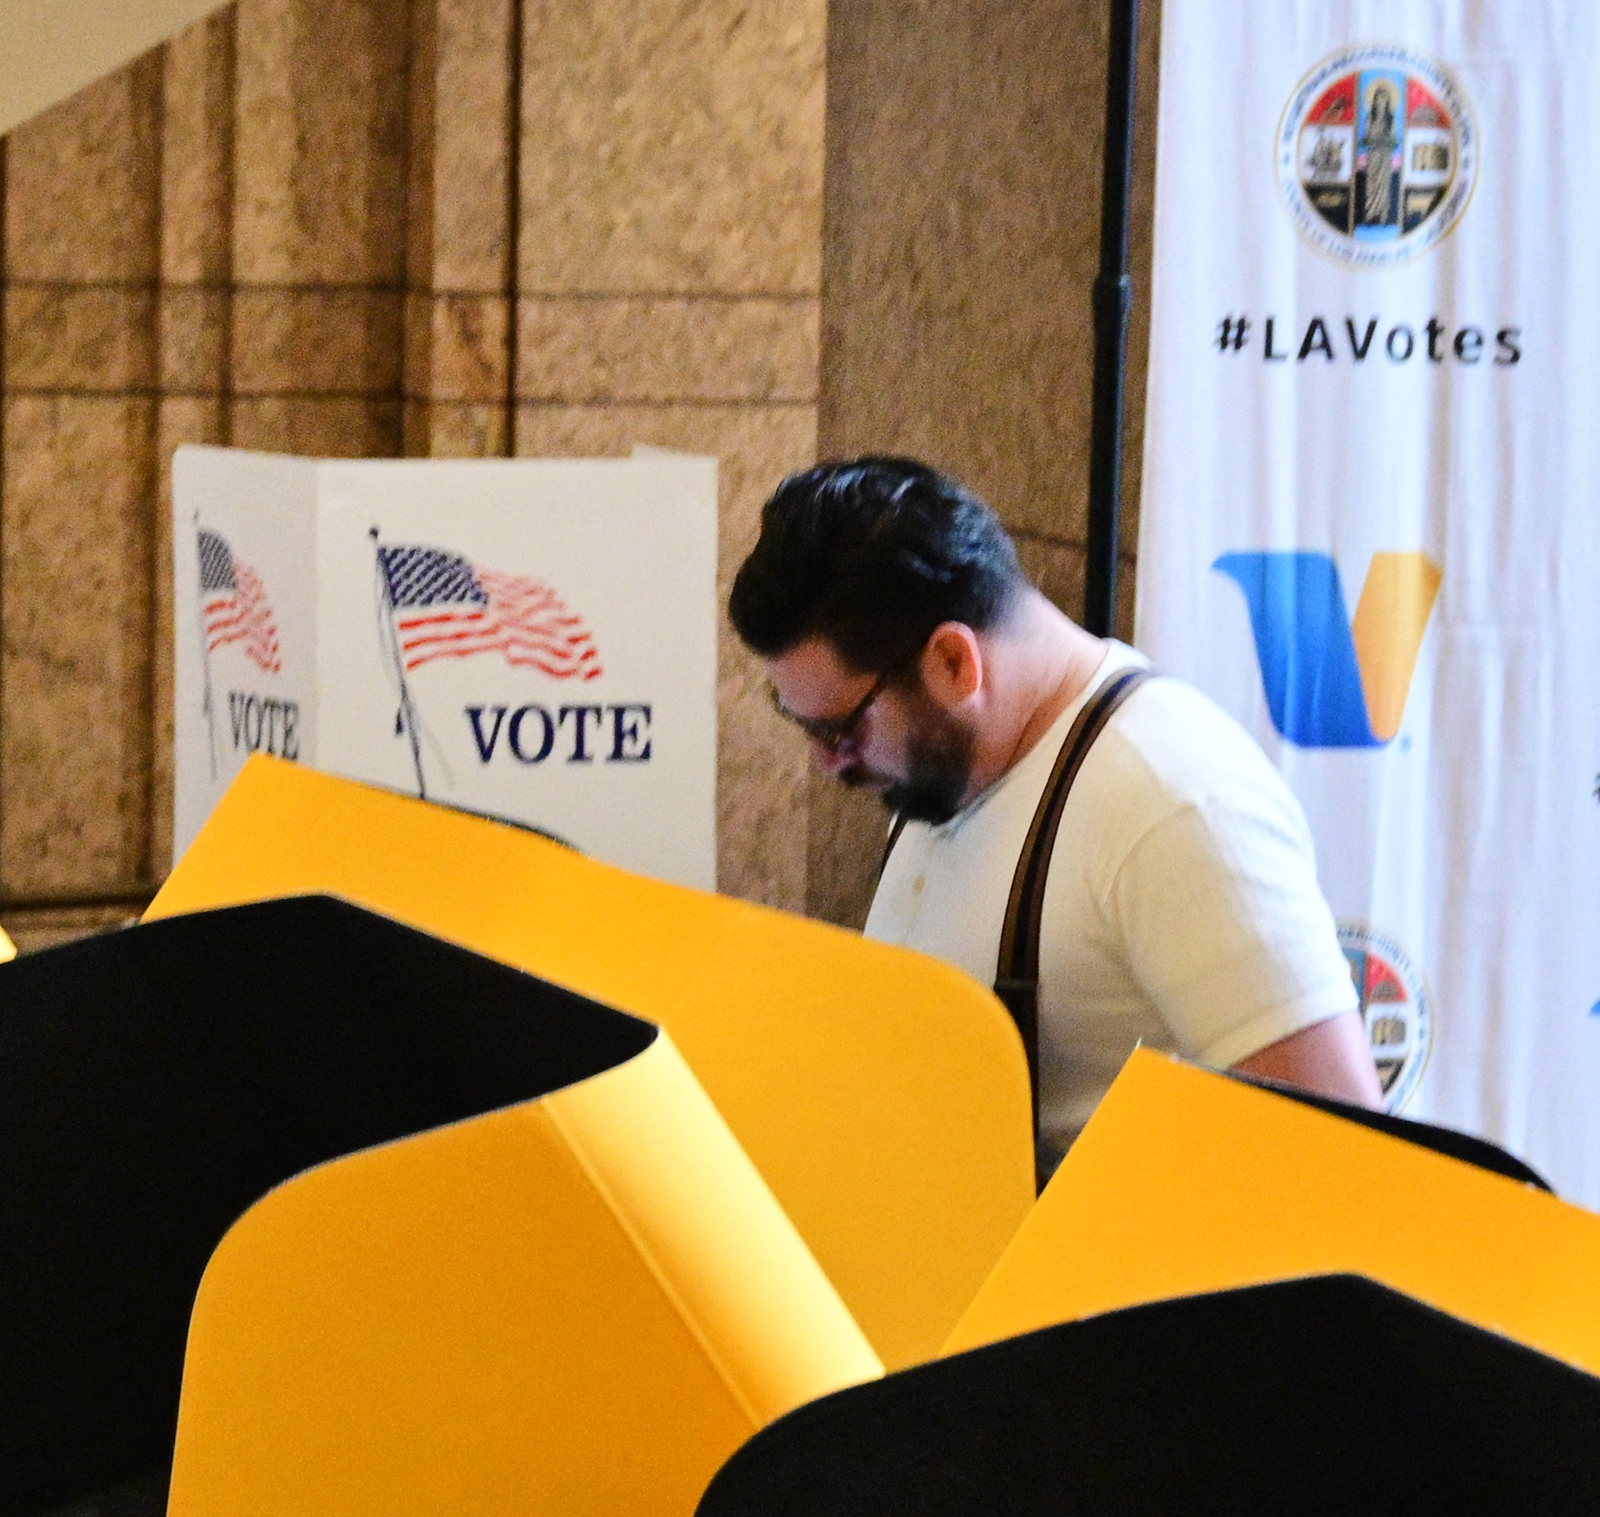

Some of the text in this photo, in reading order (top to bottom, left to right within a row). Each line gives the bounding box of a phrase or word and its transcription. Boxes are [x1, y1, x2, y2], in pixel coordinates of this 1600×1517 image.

[1215, 314, 1523, 368] #LAVotes
[229, 692, 299, 760] VOTE
[464, 704, 654, 764] VOTE
